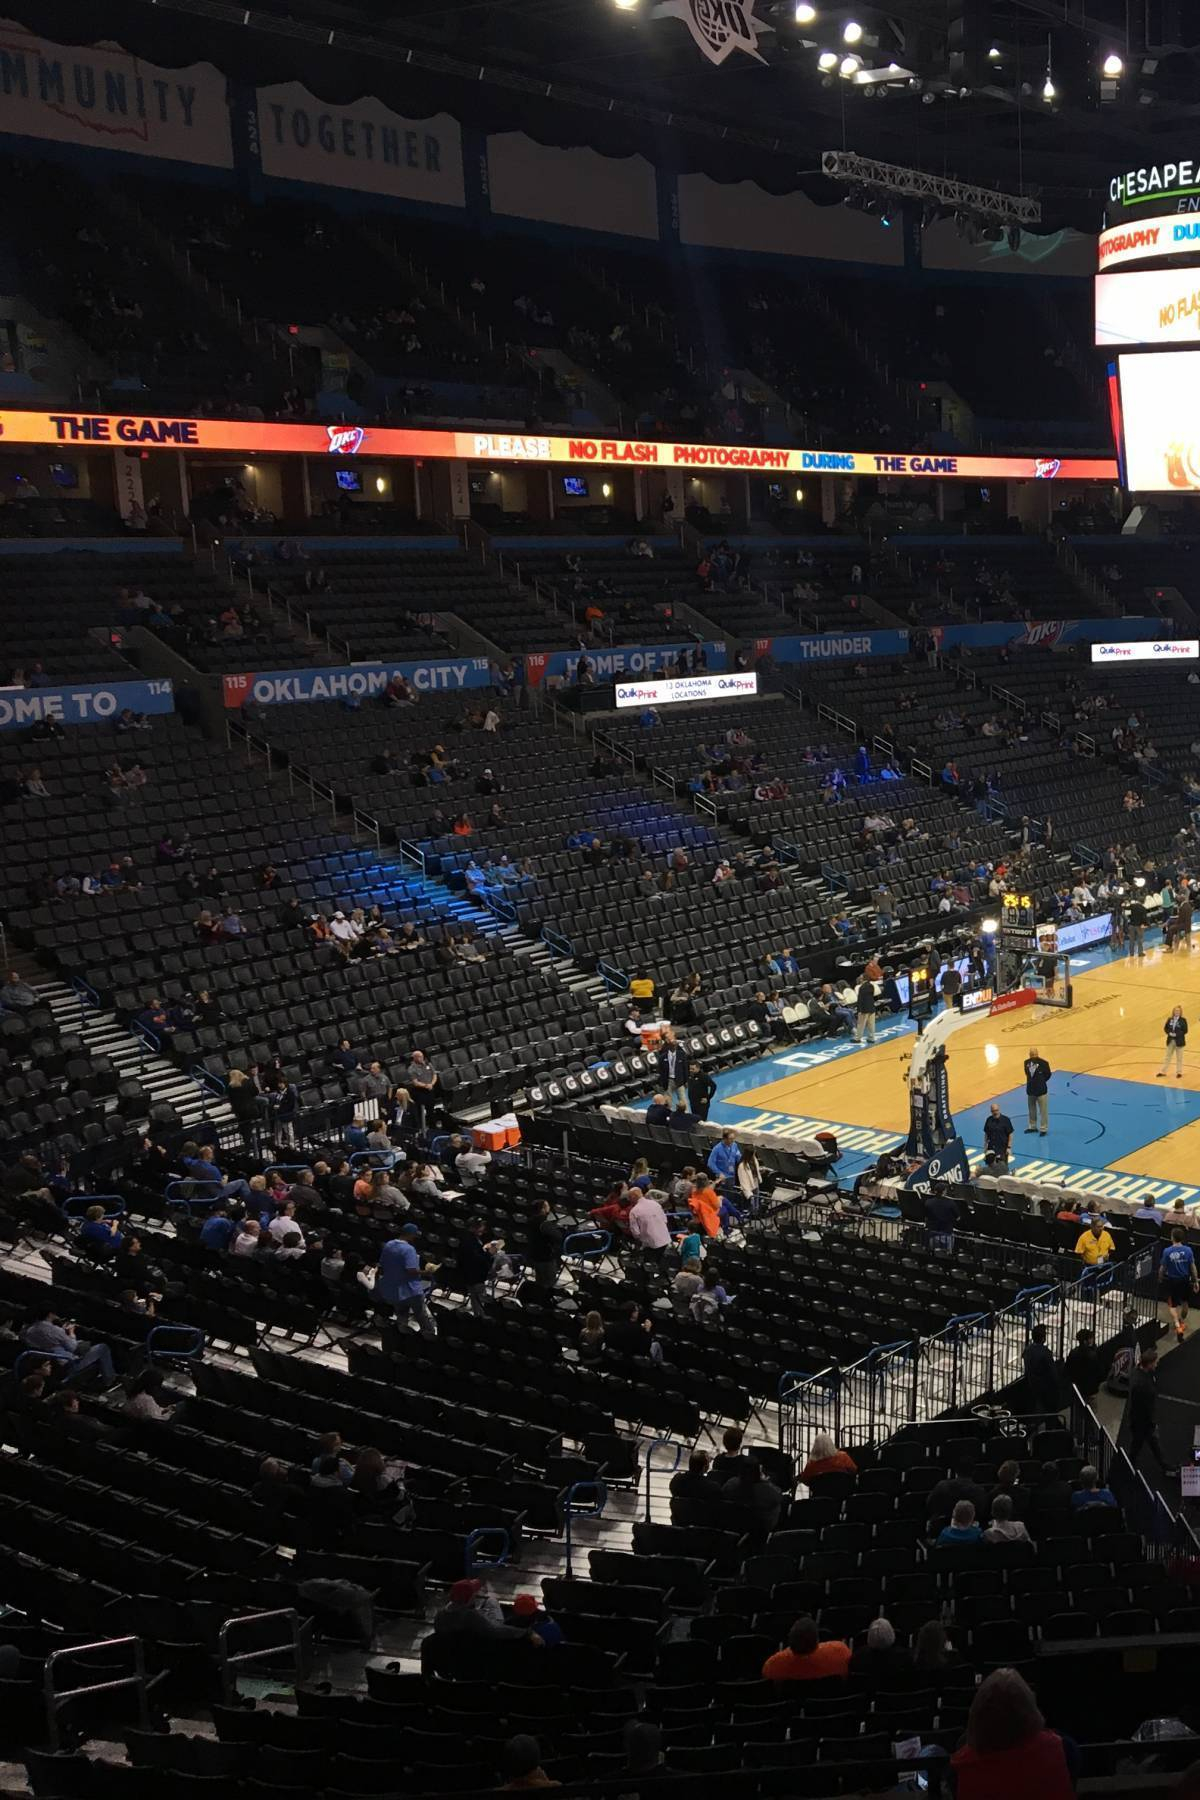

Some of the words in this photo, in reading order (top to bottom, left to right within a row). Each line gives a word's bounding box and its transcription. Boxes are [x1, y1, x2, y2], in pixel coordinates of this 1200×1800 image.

[270, 103, 441, 173] TOGETHER
[1159, 304, 1175, 329] NO
[50, 416, 110, 441] THE
[117, 419, 199, 444] GAME
[473, 435, 552, 457] PLEASE
[569, 440, 598, 460] NO
[601, 442, 658, 462] FLASH
[673, 447, 790, 468] PHOTOGRAPHY
[801, 453, 855, 470] DURING
[874, 455, 906, 472] THE
[910, 456, 958, 473] GAME
[755, 640, 769, 650] 117
[800, 637, 873, 658] THUNDER
[472, 659, 489, 670] 115
[528, 655, 545, 666] 116
[629, 652, 656, 672] OF
[224, 675, 247, 689] 115
[413, 665, 468, 690] CITY
[674, 680, 712, 689] OKLAHOMA
[148, 681, 172, 695] 114
[72, 691, 117, 717] TO
